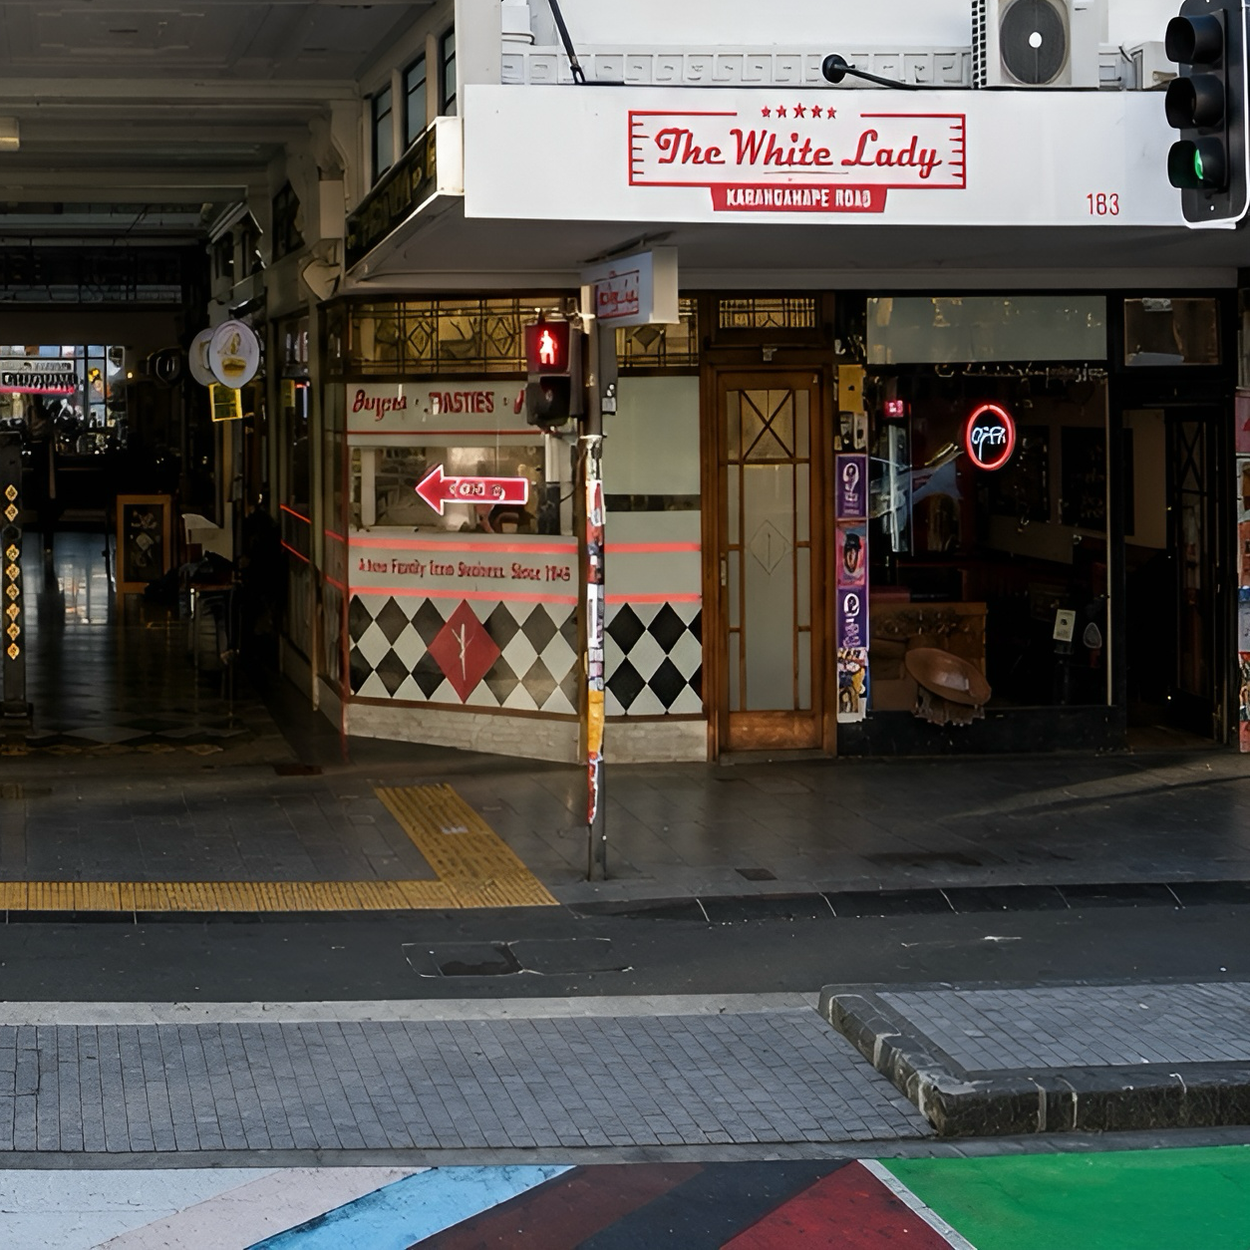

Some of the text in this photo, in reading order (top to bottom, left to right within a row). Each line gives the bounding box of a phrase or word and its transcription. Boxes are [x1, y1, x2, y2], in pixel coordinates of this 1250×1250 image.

[654, 127, 943, 179] The White Lady
[1086, 192, 1120, 216] 183
